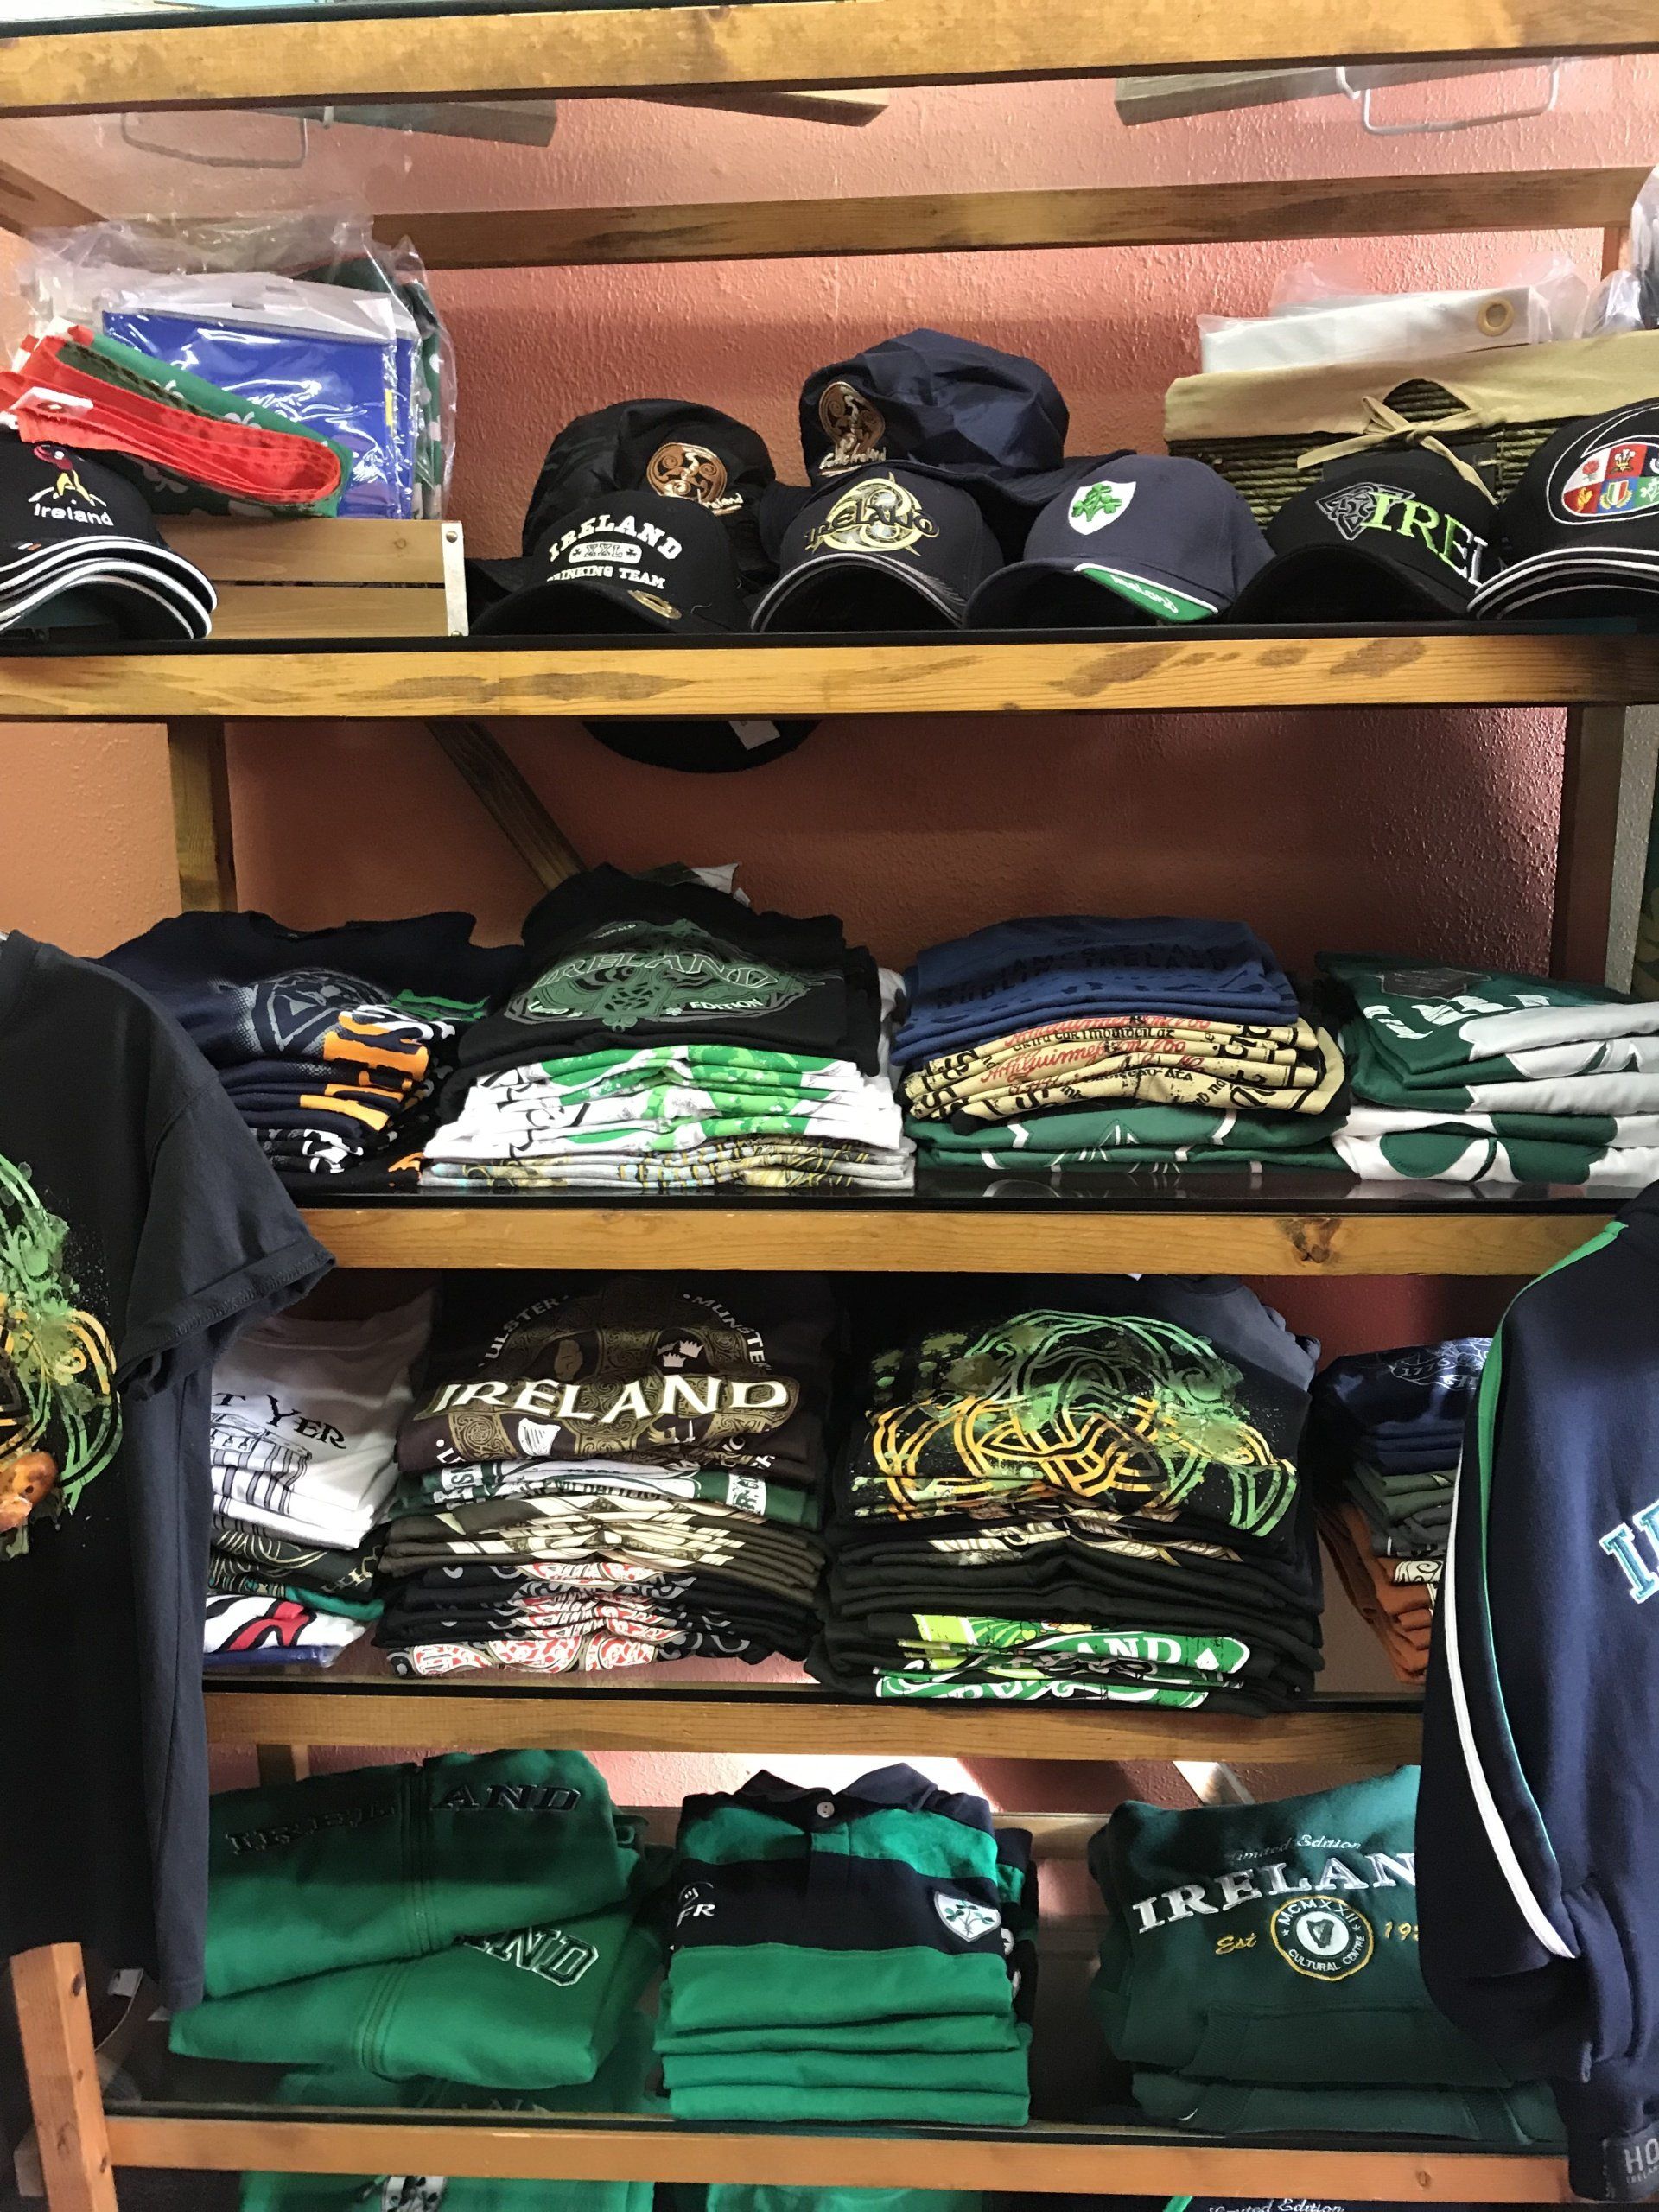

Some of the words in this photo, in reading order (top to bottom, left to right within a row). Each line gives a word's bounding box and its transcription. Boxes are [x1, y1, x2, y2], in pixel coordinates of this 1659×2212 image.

[34, 503, 114, 526] Ireland
[549, 514, 683, 562] IRELAND
[584, 543, 623, 559] XXL
[619, 567, 666, 589] TEAM
[533, 953, 778, 988] IRELAND
[689, 997, 764, 1009] EDITION
[485, 1298, 560, 1359] ULSTER
[433, 1375, 787, 1424] IRELAND
[266, 1394, 346, 1449] YER
[1297, 1834, 1362, 1849] Edition
[1278, 1898, 1360, 1926] MCMXXII
[1215, 1932, 1258, 1955] Est
[1385, 1921, 1419, 1943] 19
[1288, 1948, 1341, 1972] CULTURAL
[1342, 1935, 1366, 1965] CENTRE
